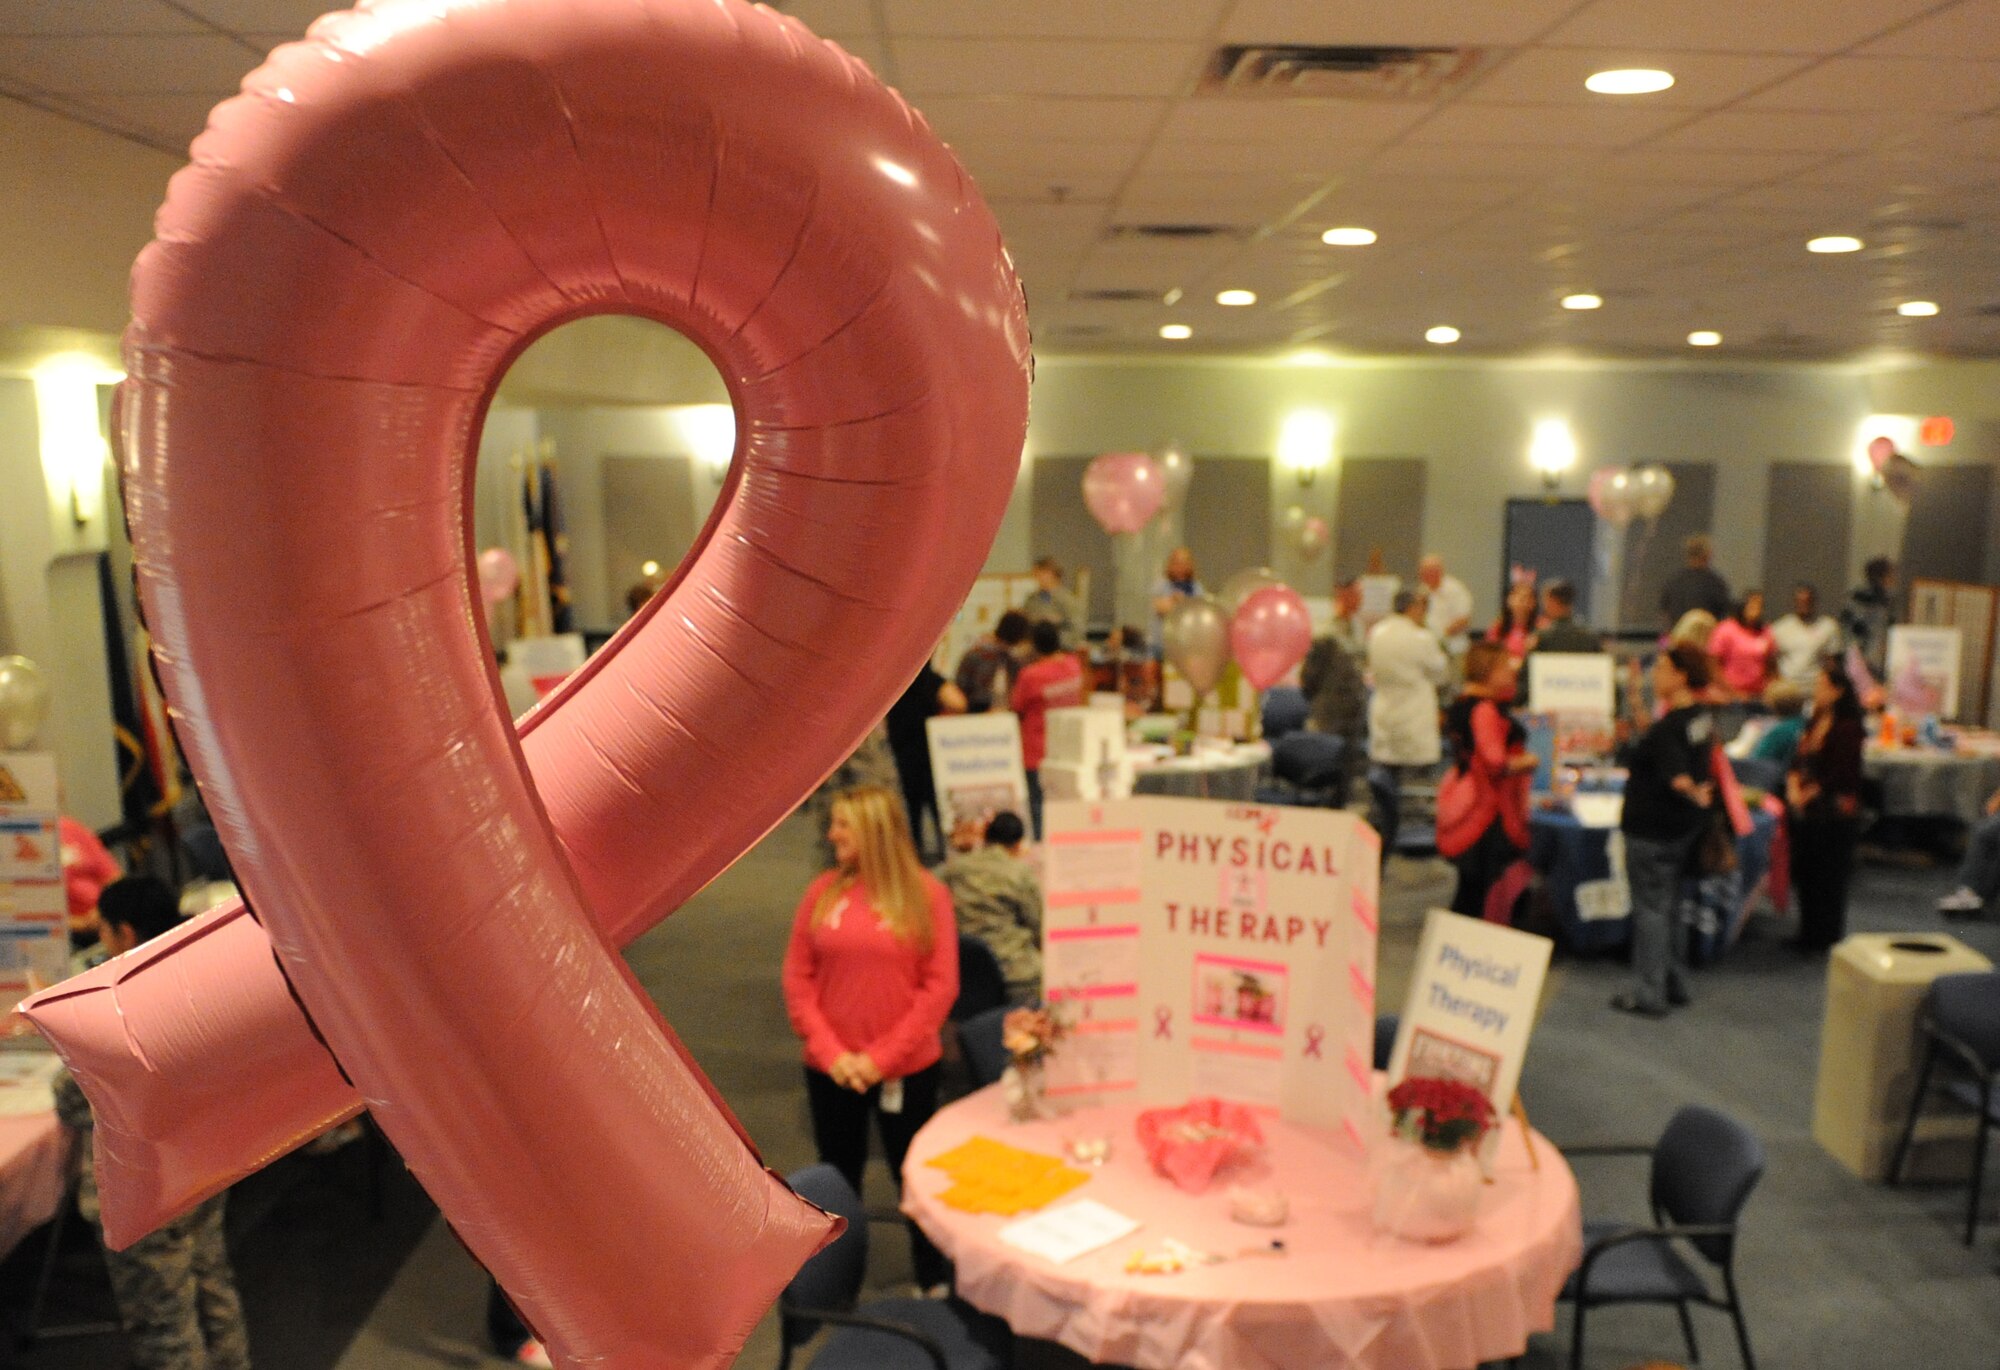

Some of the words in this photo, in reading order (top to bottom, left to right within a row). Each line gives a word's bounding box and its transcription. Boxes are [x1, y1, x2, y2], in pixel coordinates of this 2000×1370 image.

[1157, 831, 1338, 876] PHYSICAL
[1166, 903, 1331, 946] THERAPY
[1439, 944, 1521, 987] Physical
[1431, 983, 1509, 1032] Therapy
